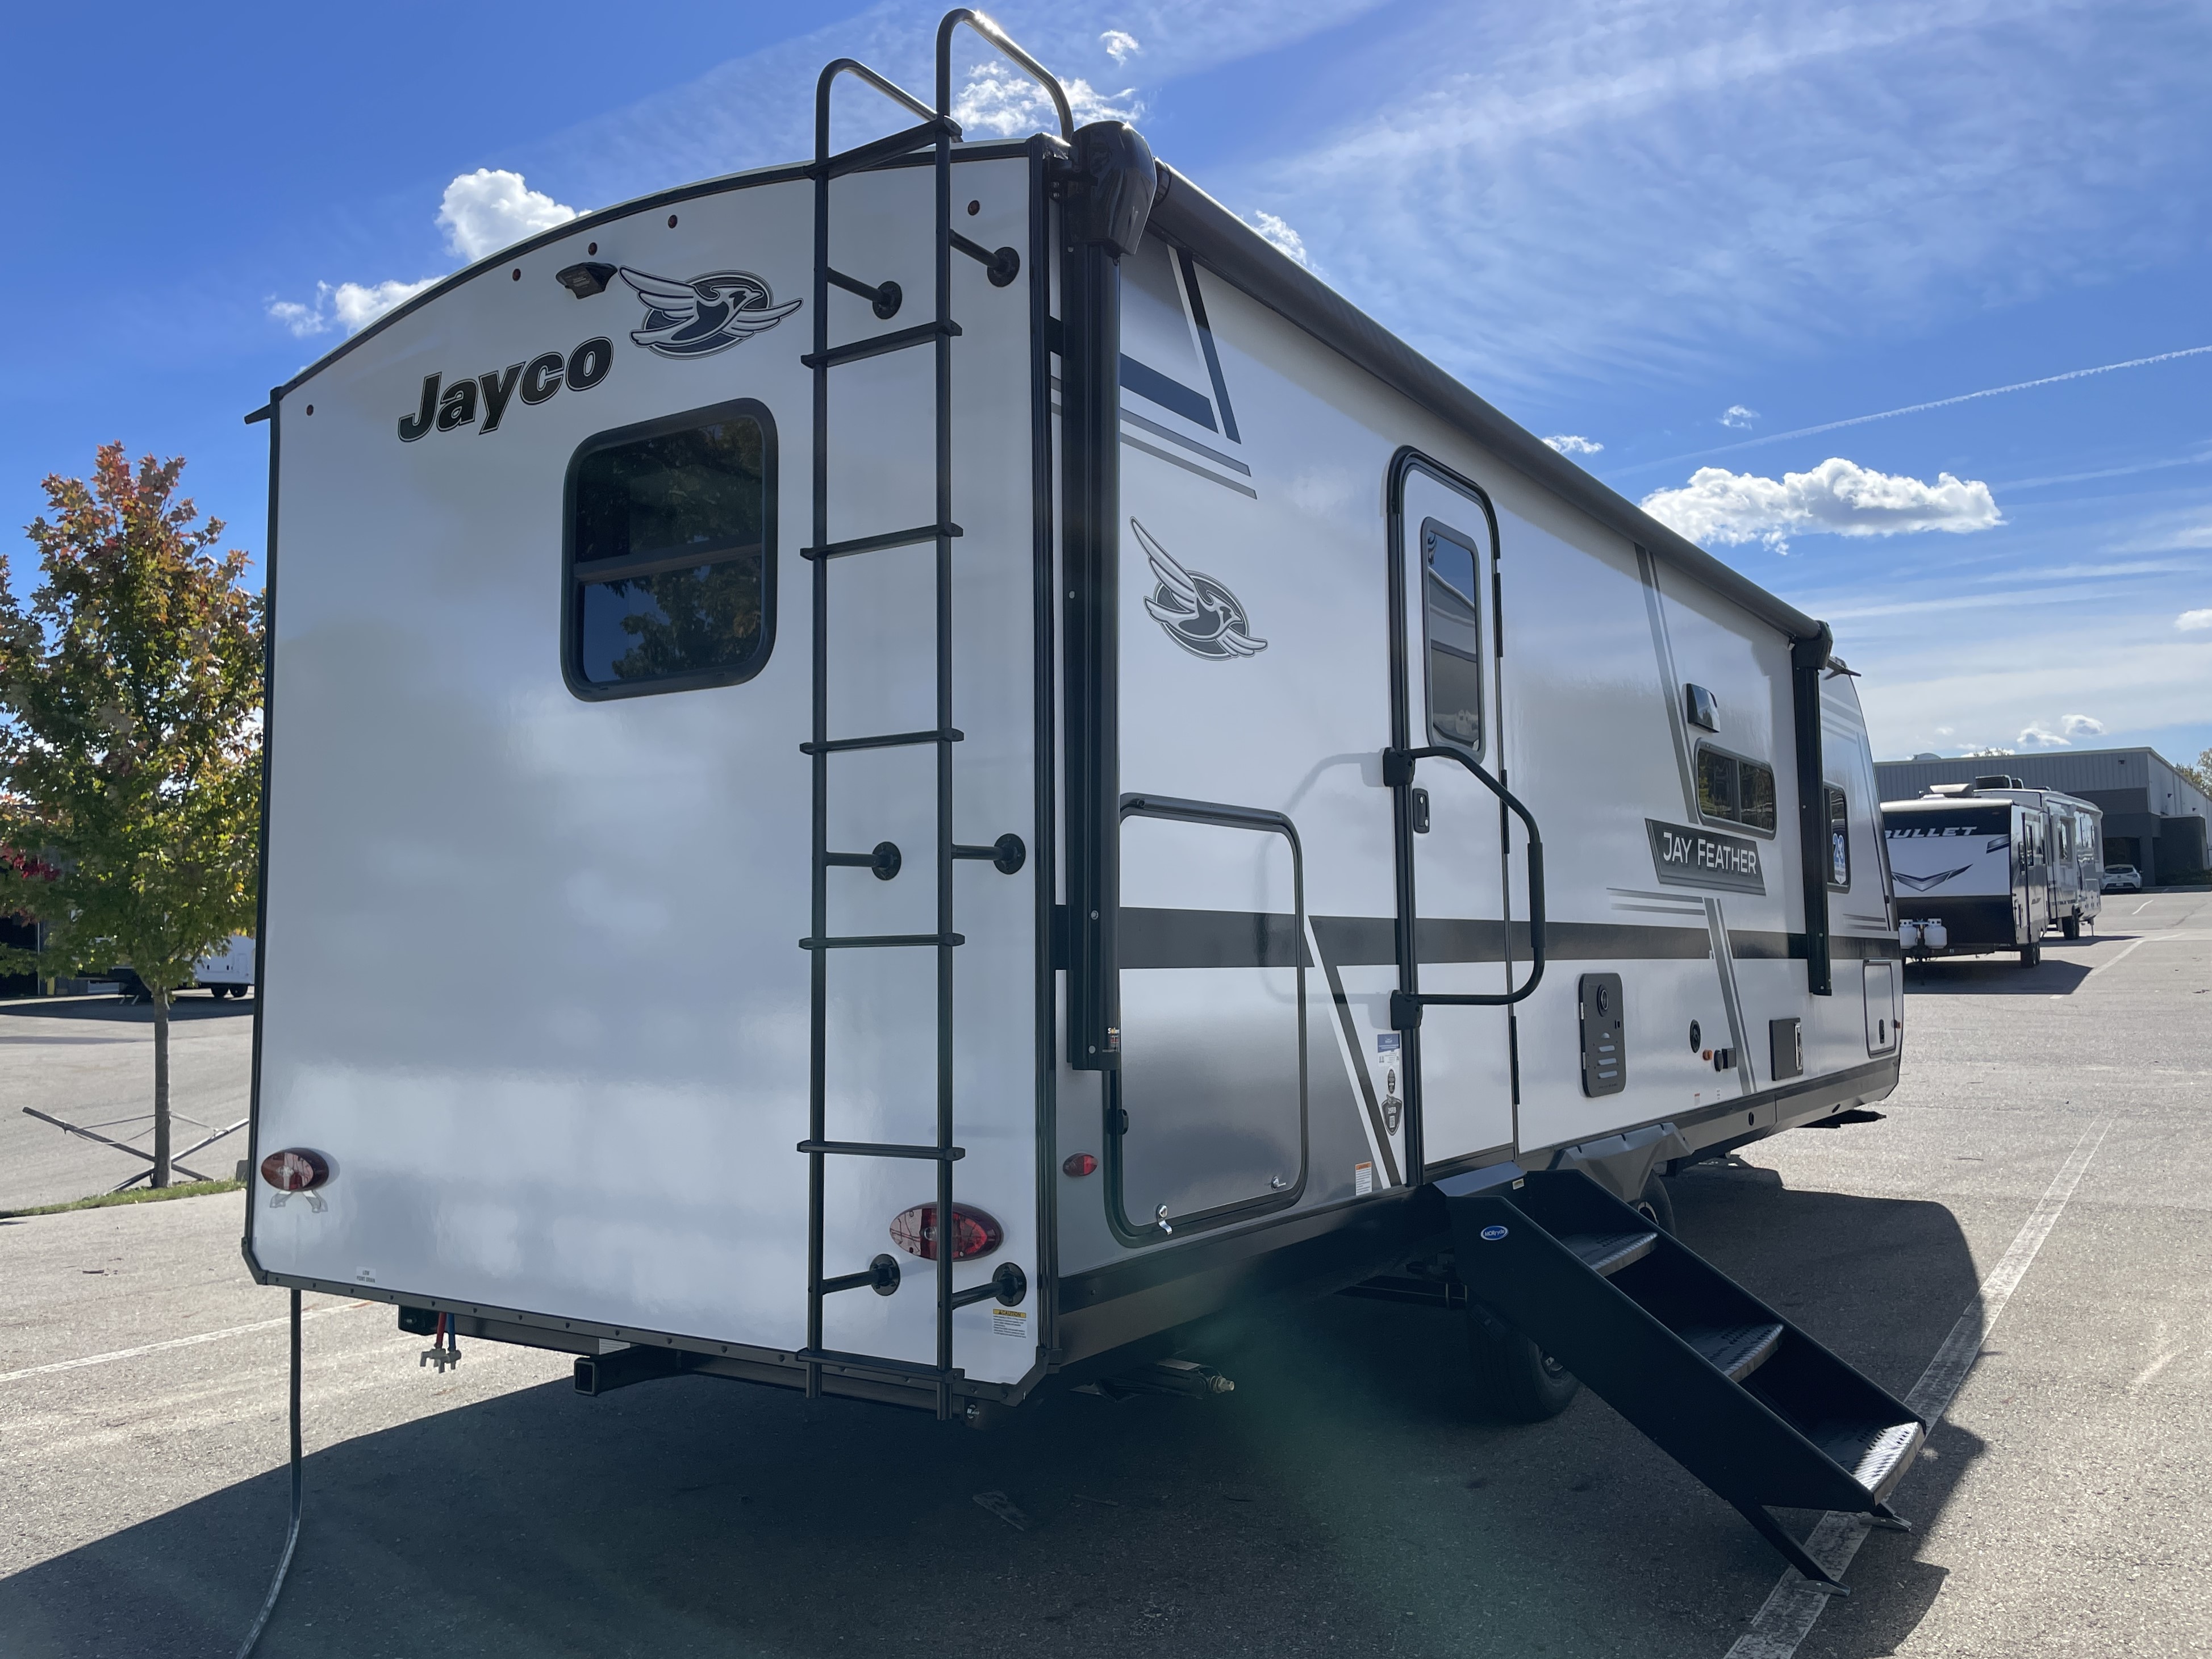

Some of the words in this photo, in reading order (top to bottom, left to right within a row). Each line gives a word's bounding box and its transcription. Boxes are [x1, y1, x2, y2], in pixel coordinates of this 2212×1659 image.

[398, 336, 614, 442] Jayco
[1663, 832, 1692, 864] JAY
[1697, 838, 1757, 874] FEATHER
